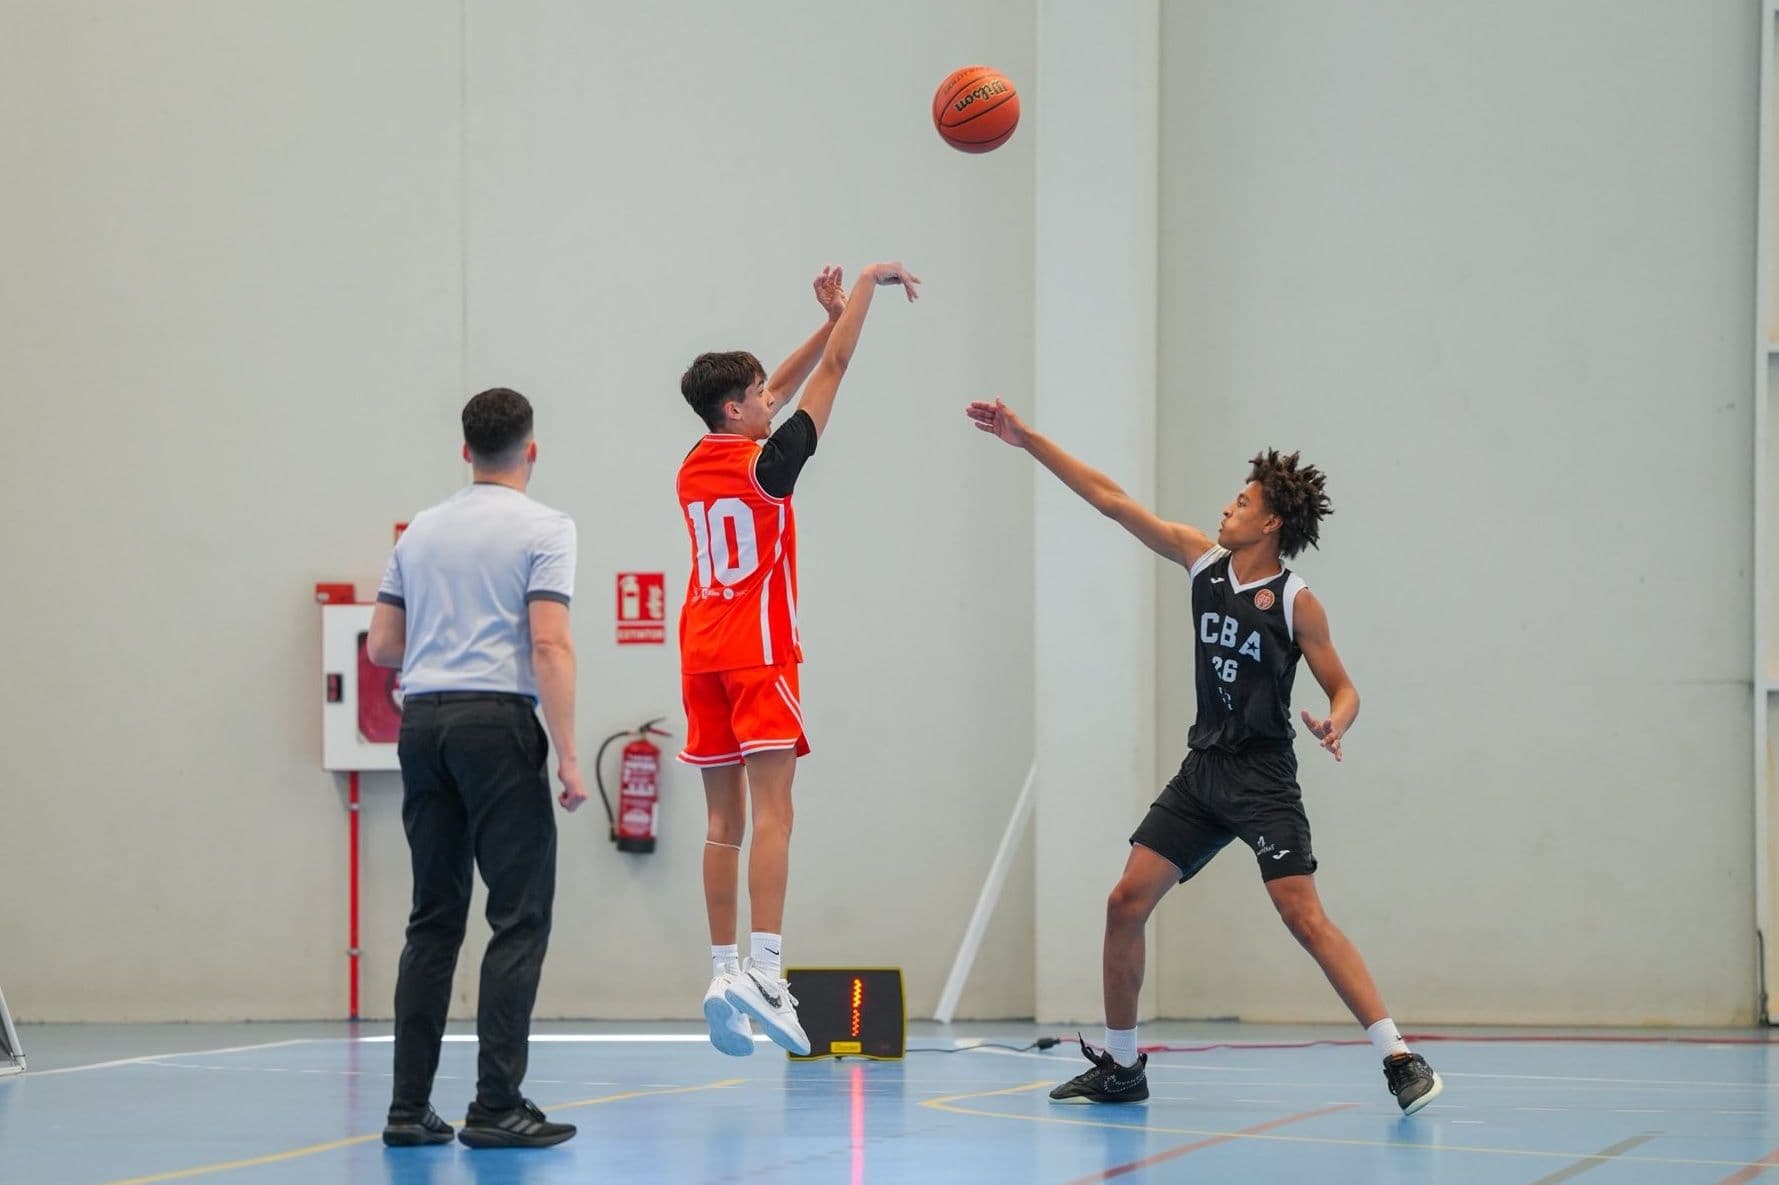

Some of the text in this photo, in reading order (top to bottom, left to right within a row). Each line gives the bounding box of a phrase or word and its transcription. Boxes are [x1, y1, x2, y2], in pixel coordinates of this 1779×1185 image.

[955, 79, 1007, 111] Wilson
[687, 498, 759, 588] 10
[1201, 612, 1261, 662] CBA
